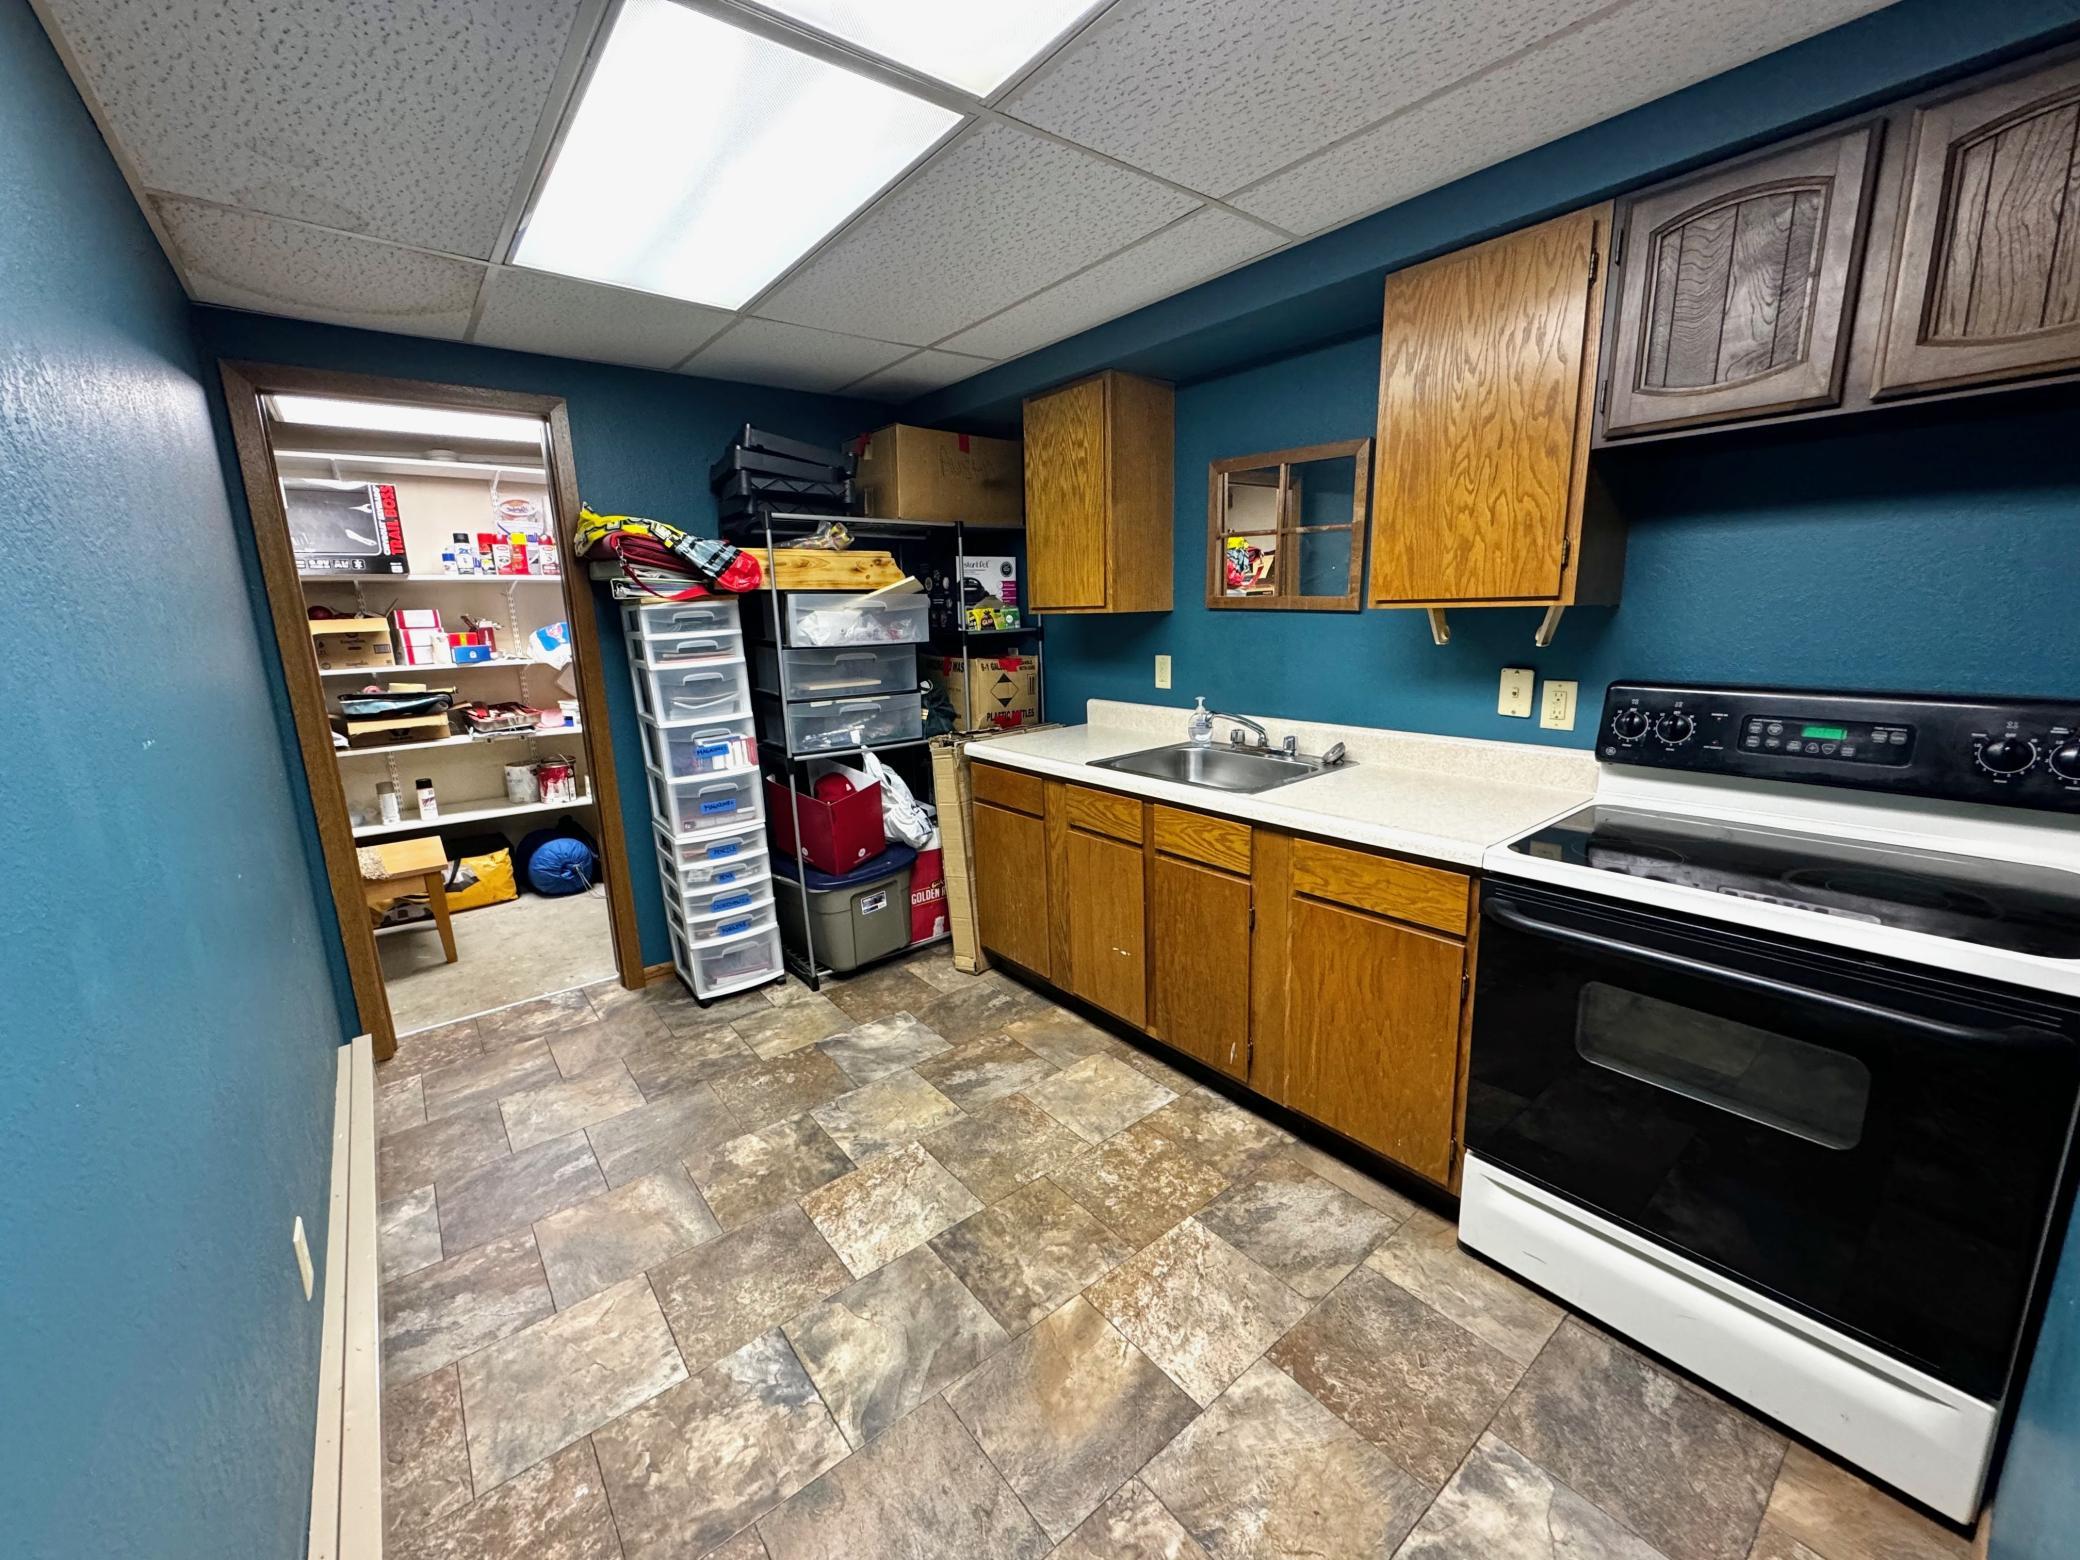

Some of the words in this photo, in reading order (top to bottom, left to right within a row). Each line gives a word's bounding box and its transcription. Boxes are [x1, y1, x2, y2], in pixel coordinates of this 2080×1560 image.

[380, 485, 397, 517] BOSS
[386, 520, 404, 555] TRAIL
[911, 888, 940, 905] GOLDEN
